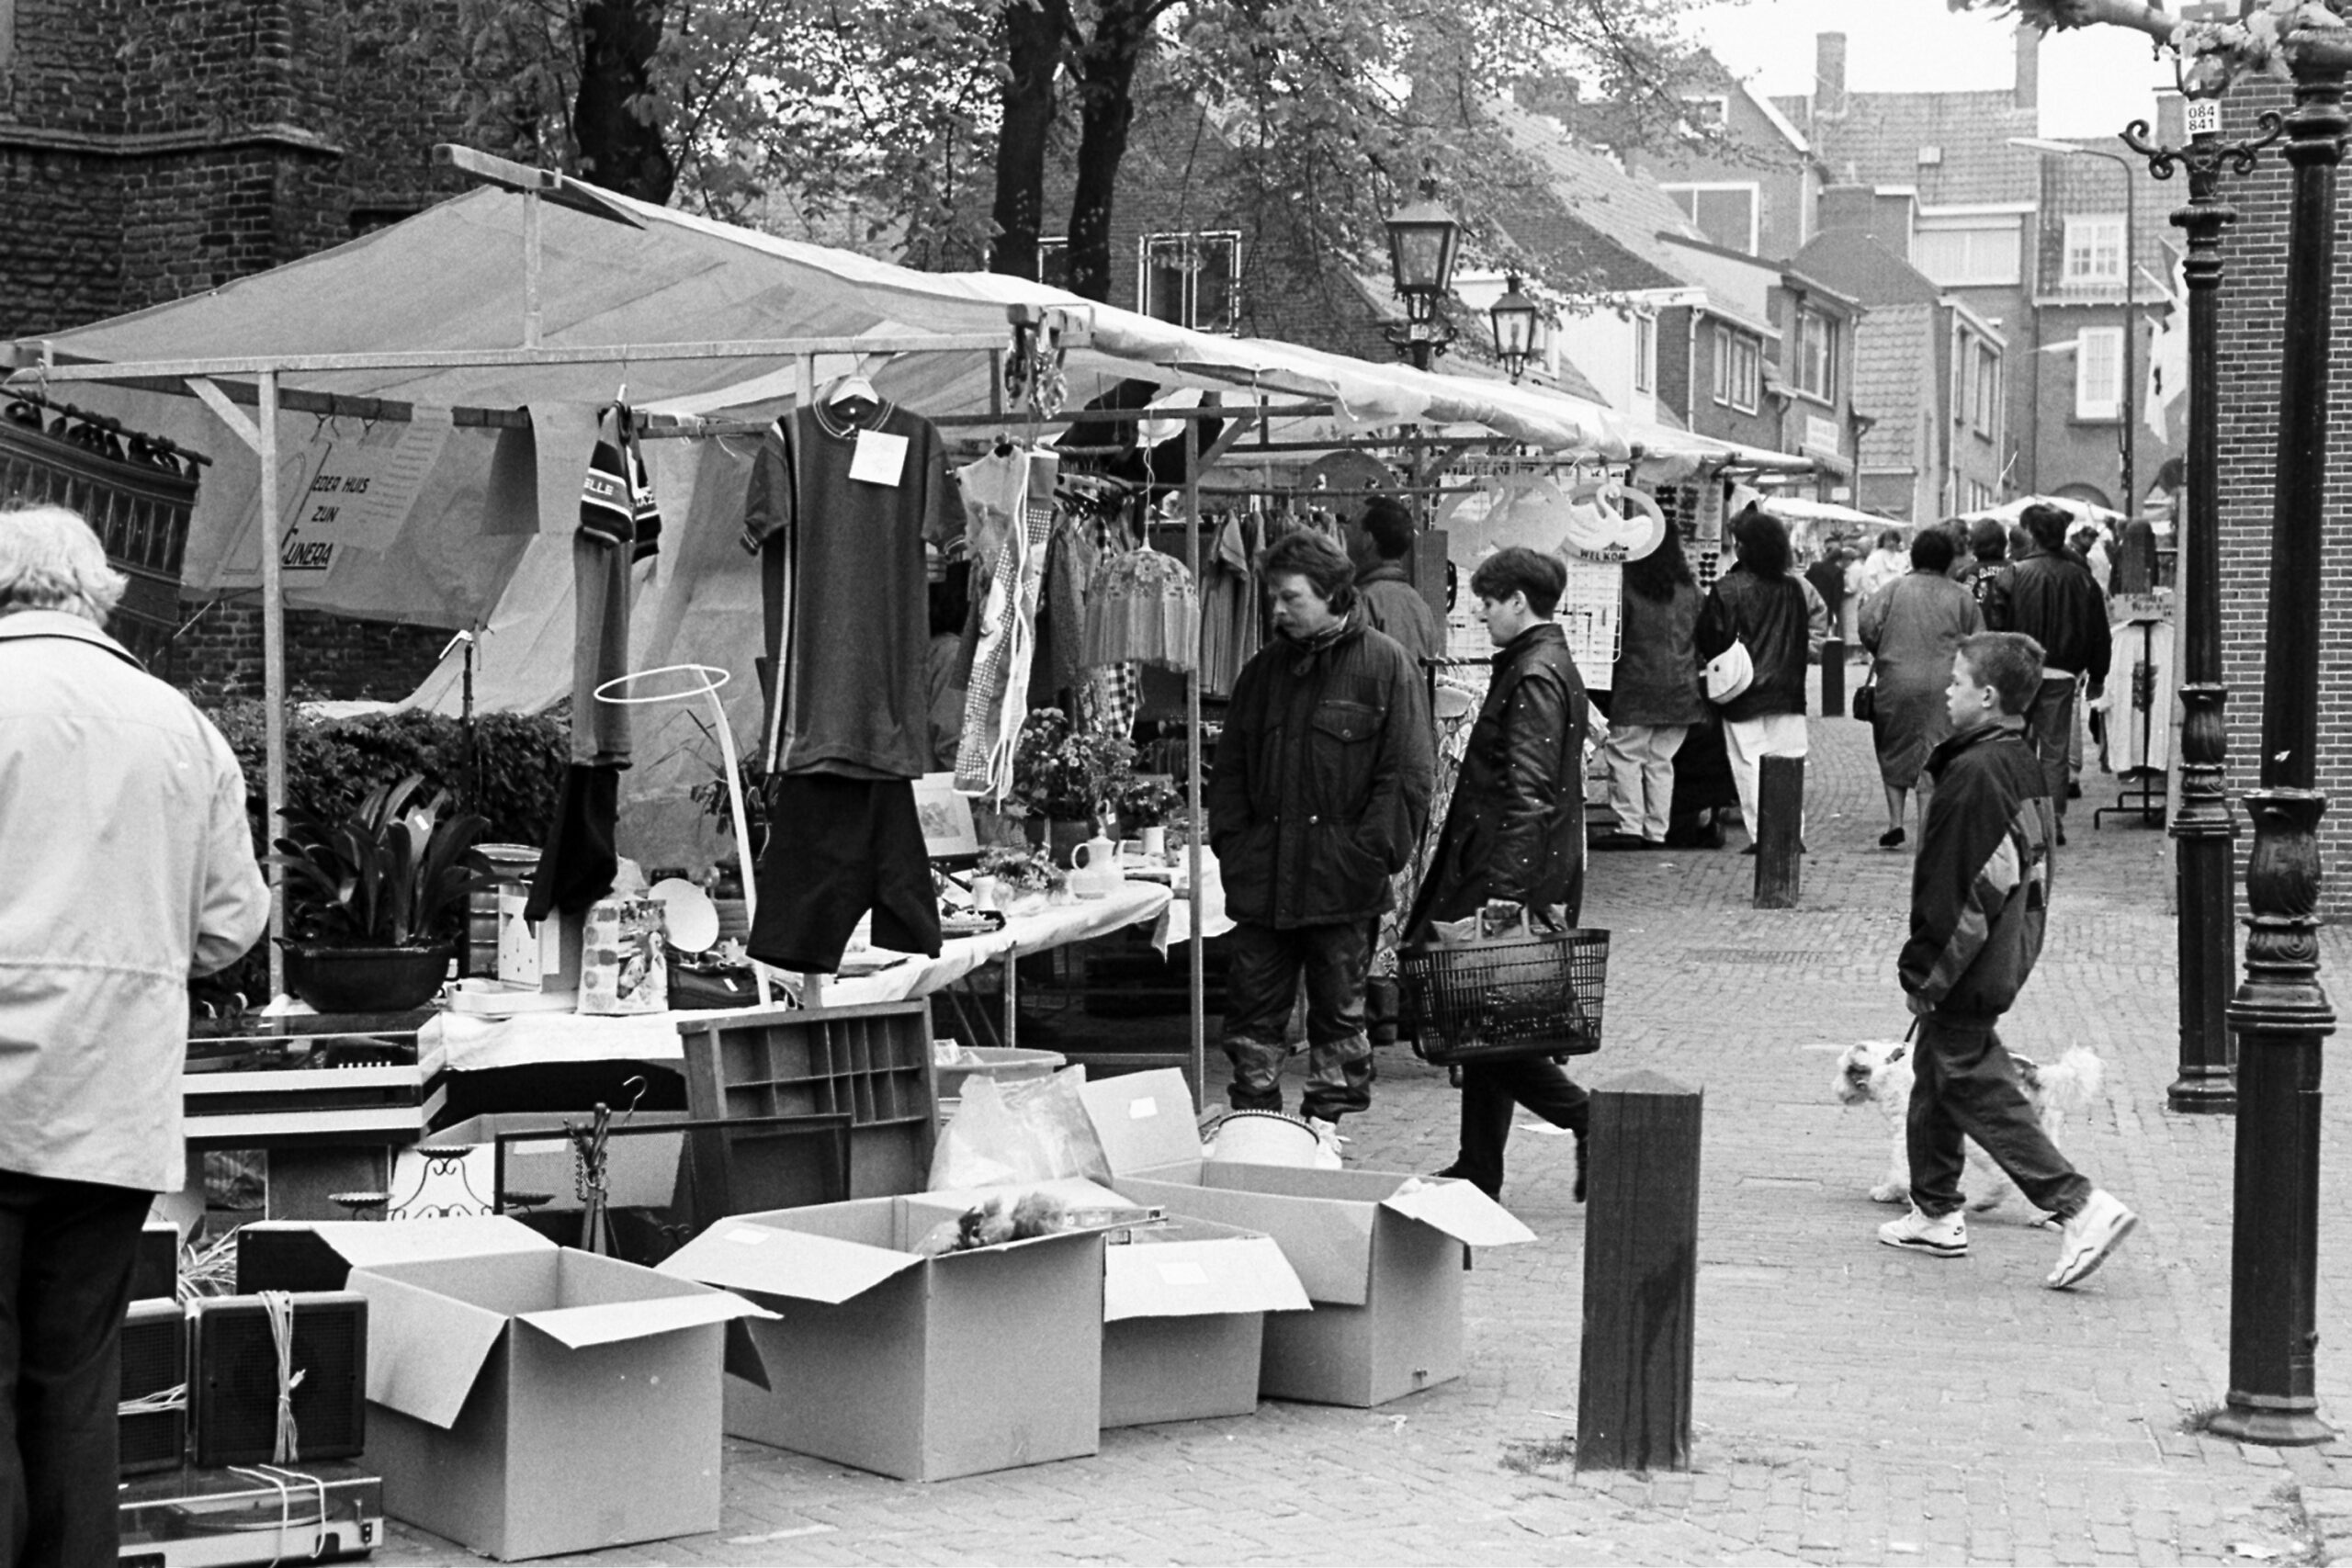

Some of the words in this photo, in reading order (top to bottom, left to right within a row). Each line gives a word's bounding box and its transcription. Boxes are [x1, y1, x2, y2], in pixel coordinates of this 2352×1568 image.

[2188, 106, 2214, 118] 084
[2188, 118, 2213, 130] 841
[342, 477, 370, 493] HUIS
[1580, 548, 1627, 562] WELKOM
